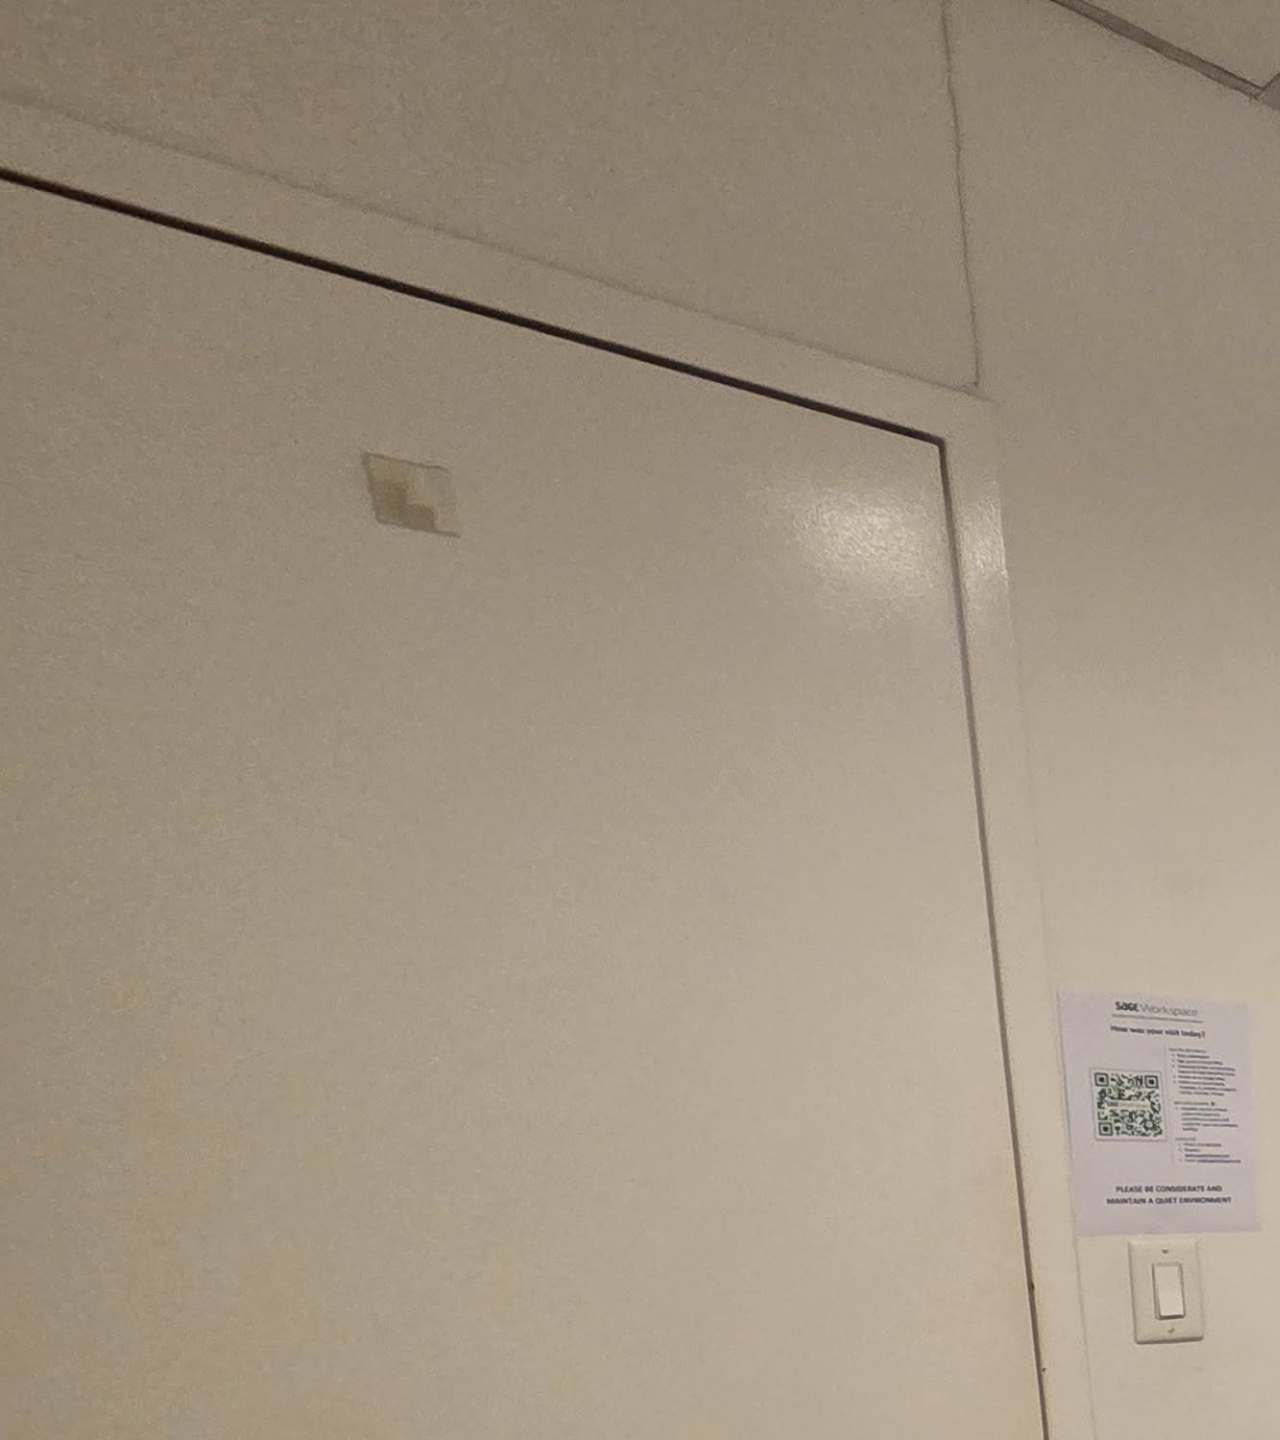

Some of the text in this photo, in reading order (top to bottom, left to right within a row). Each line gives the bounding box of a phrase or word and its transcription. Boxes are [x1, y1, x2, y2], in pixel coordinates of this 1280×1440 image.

[1115, 1185, 1222, 1193] PLEASE BE CONSIDERATE AND
[1106, 1197, 1146, 1205] MAINTAIN
[1155, 1197, 1177, 1205] QUIET
[1179, 1196, 1232, 1204] ENVIRONMENT
